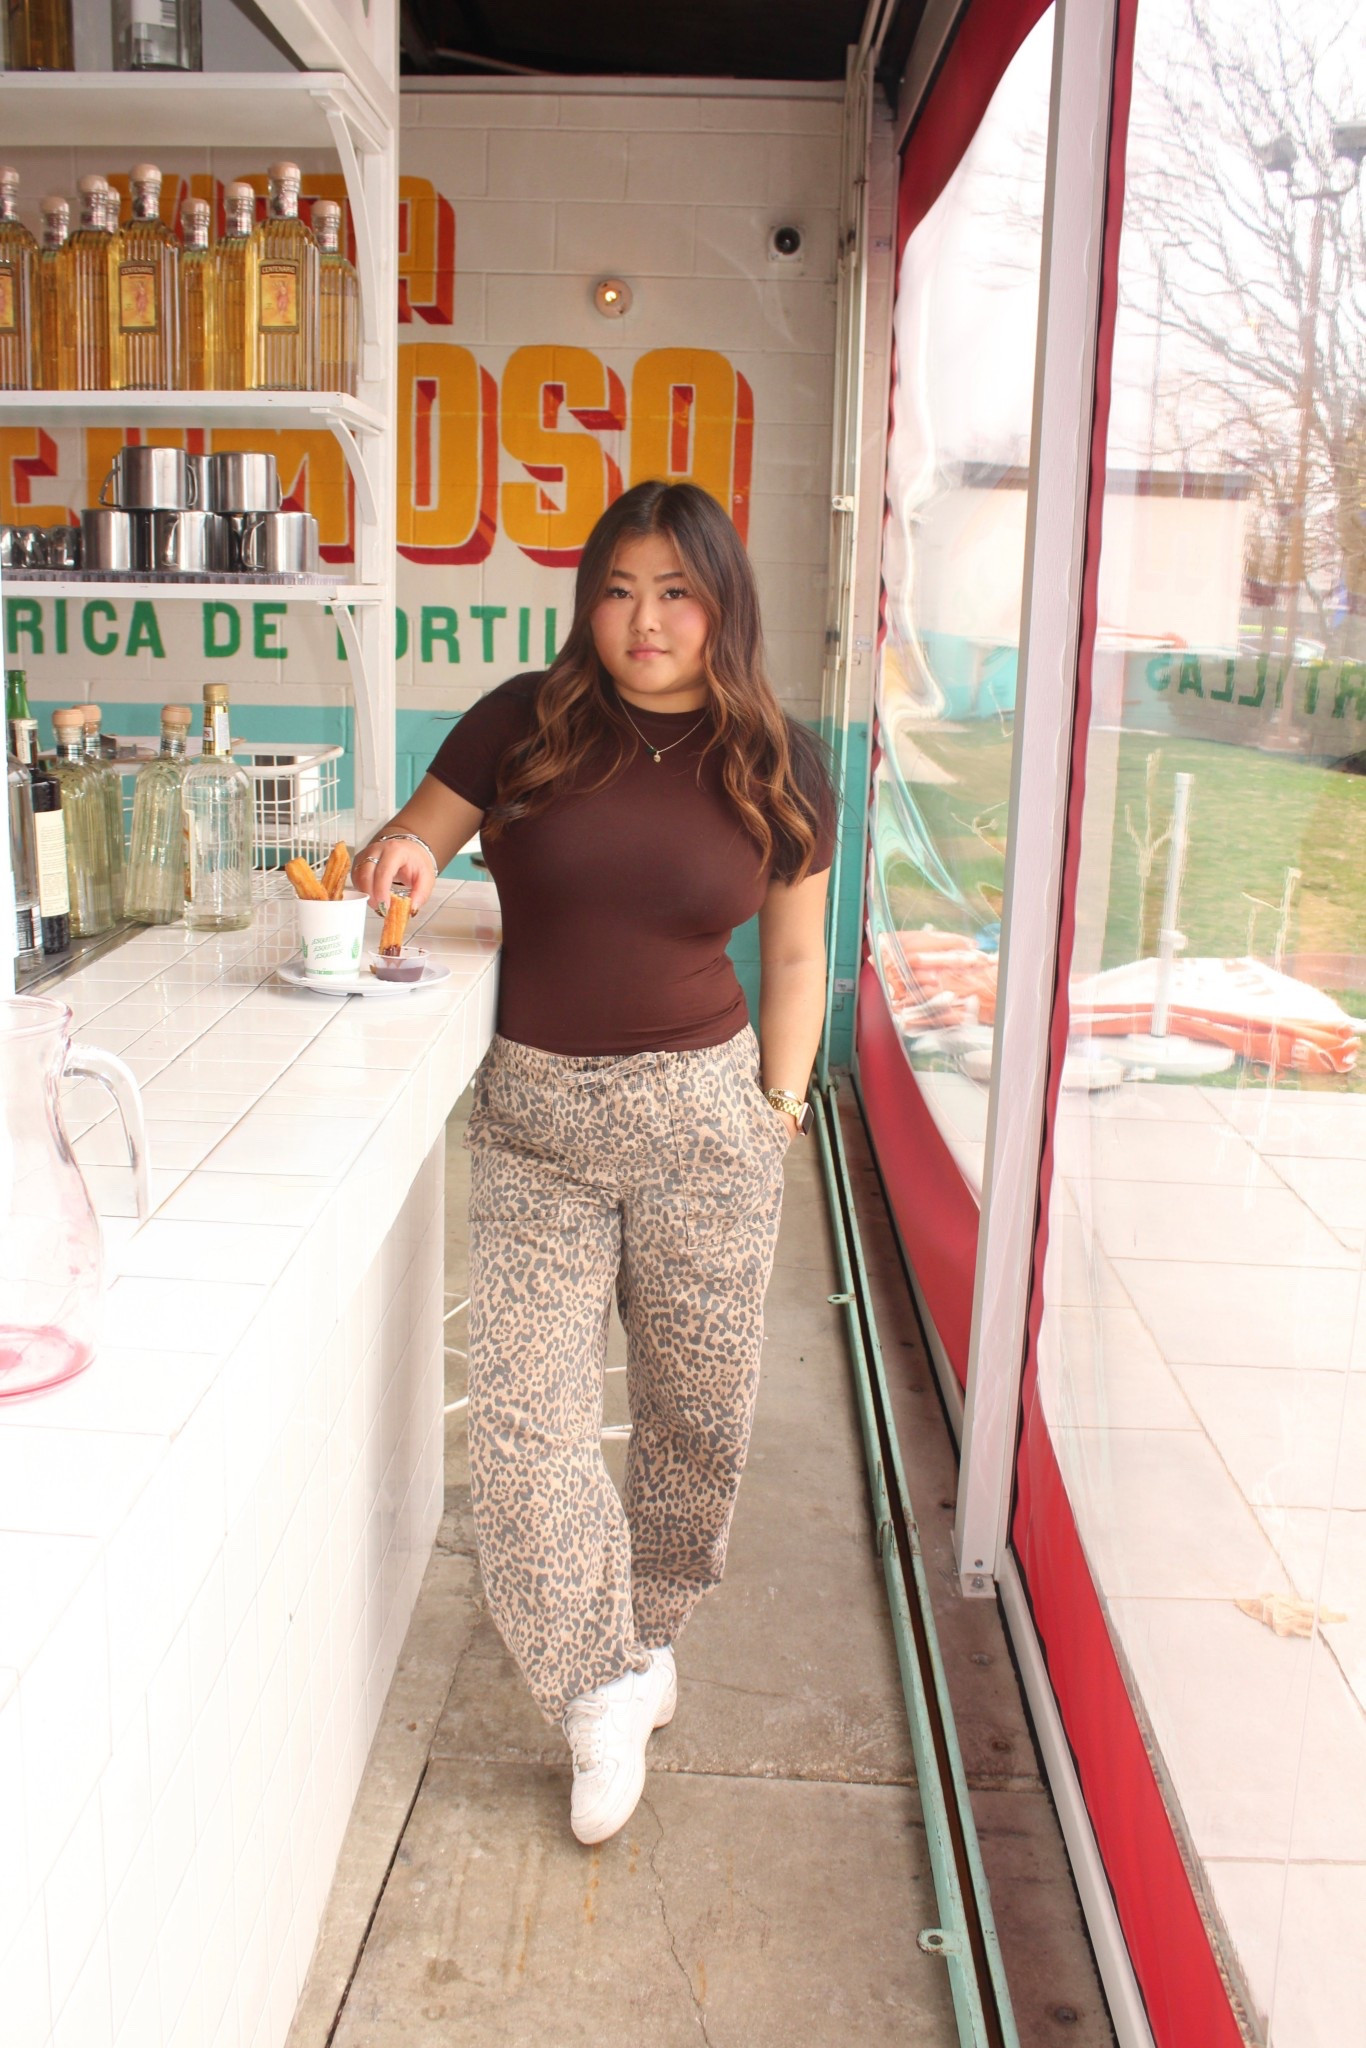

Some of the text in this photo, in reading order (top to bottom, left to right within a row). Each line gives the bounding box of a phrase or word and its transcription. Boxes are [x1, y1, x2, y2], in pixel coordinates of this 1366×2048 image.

[261, 265, 296, 274] CENTENARIO
[6, 598, 166, 658] RICA
[203, 602, 288, 659] DE
